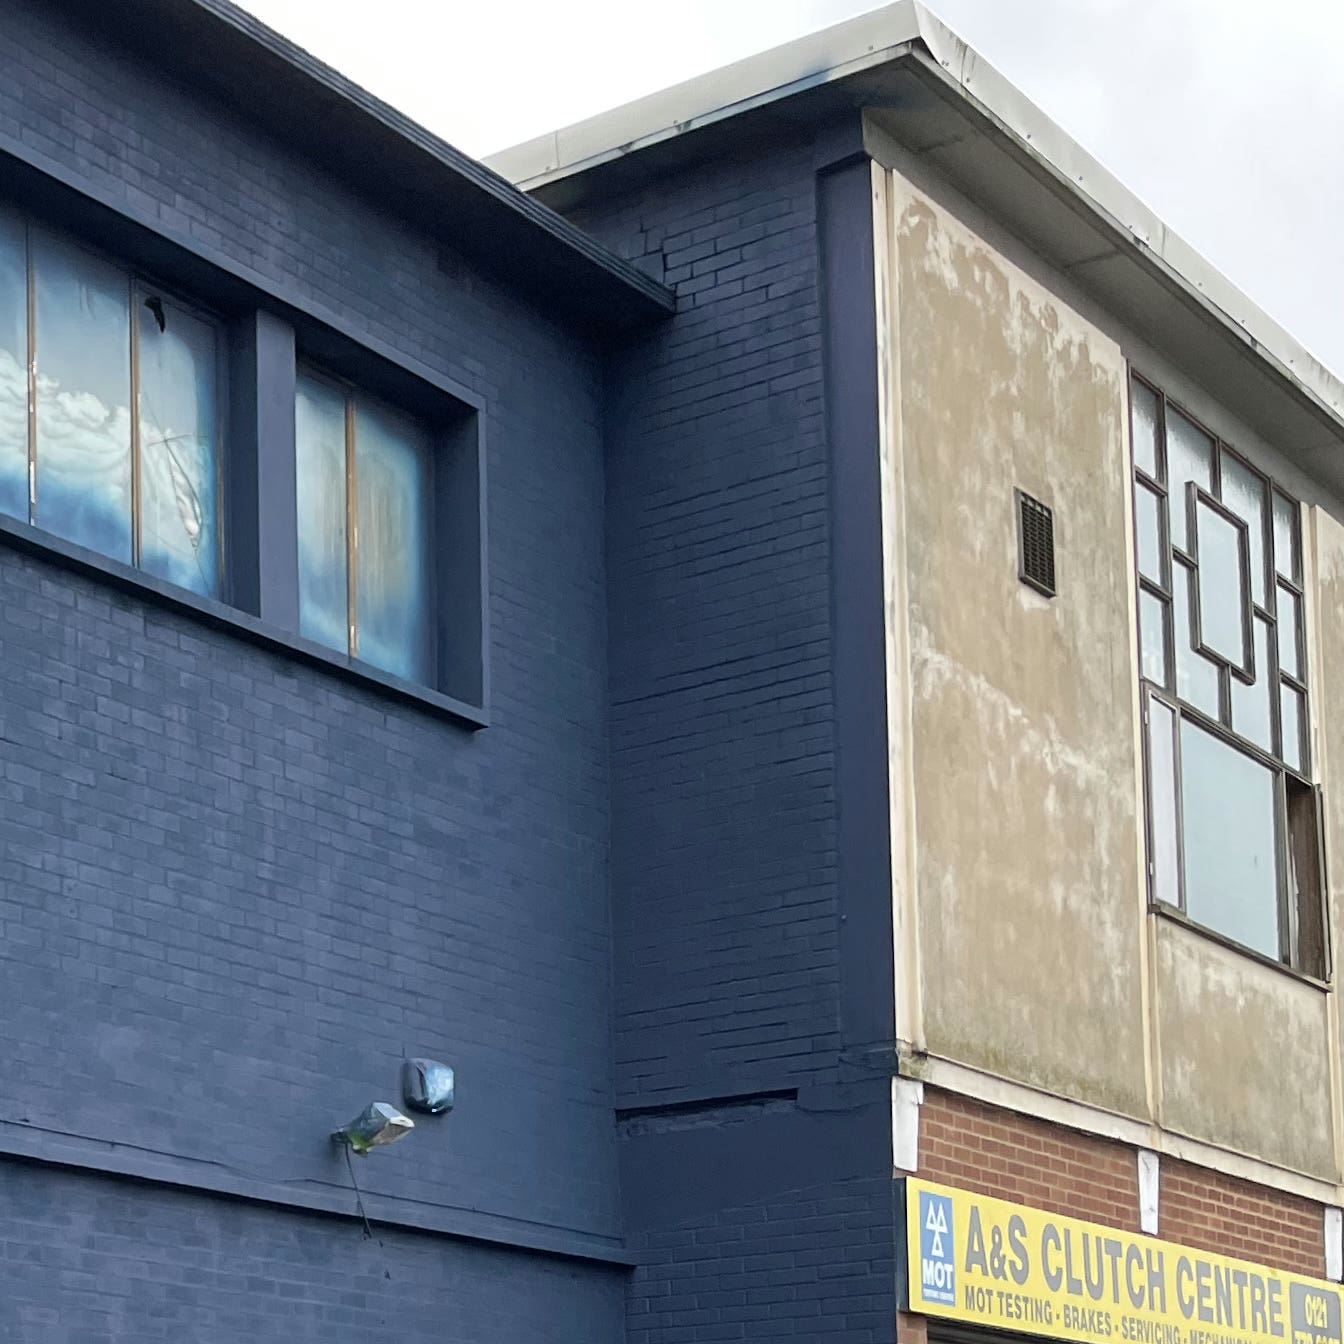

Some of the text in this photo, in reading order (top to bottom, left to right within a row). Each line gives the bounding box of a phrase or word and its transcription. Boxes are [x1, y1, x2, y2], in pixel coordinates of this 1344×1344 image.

[922, 1258, 954, 1290] MOT
[963, 1205, 1285, 1337] A&S CLUTCH CENTRE
[964, 1285, 993, 1314] MOT
[997, 1290, 1053, 1326] TESTING
[1063, 1303, 1112, 1336] BRAKES
[1304, 1294, 1328, 1328] 0121
